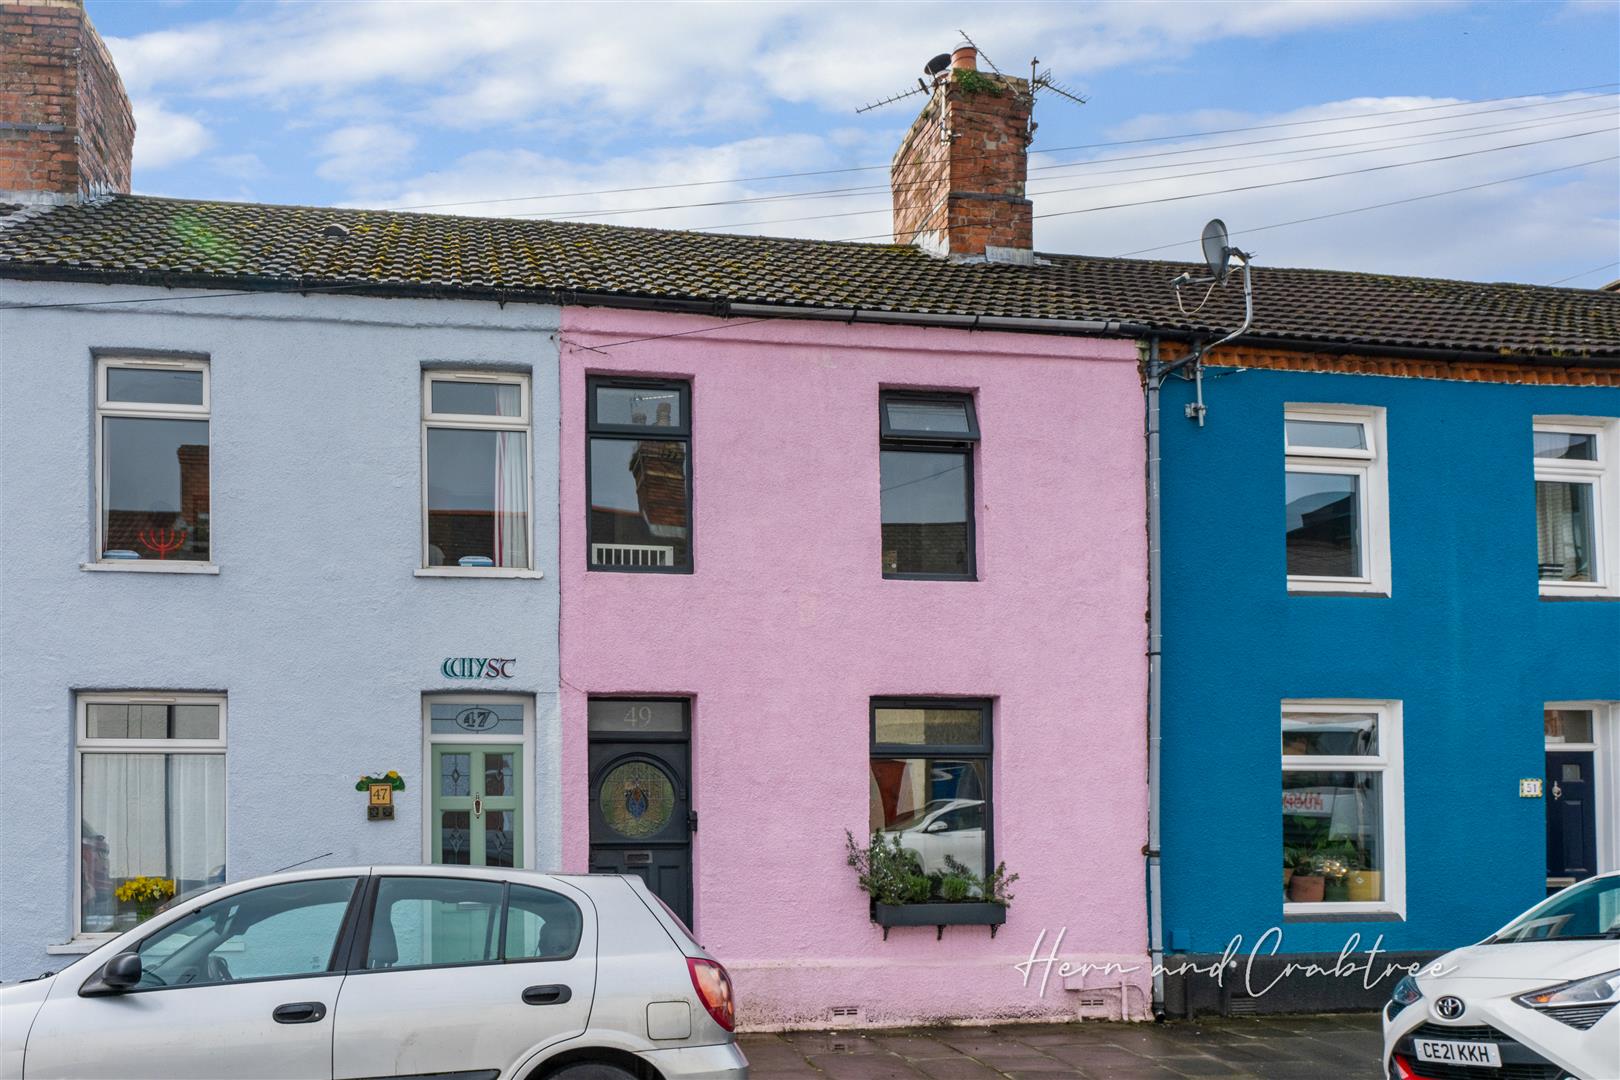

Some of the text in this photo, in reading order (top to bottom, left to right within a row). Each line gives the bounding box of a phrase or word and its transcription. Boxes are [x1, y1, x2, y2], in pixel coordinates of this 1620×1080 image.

[463, 711, 491, 728] 47
[624, 706, 651, 728] 49
[373, 788, 388, 801] 47
[1423, 1042, 1490, 1063] CE21 KKH
